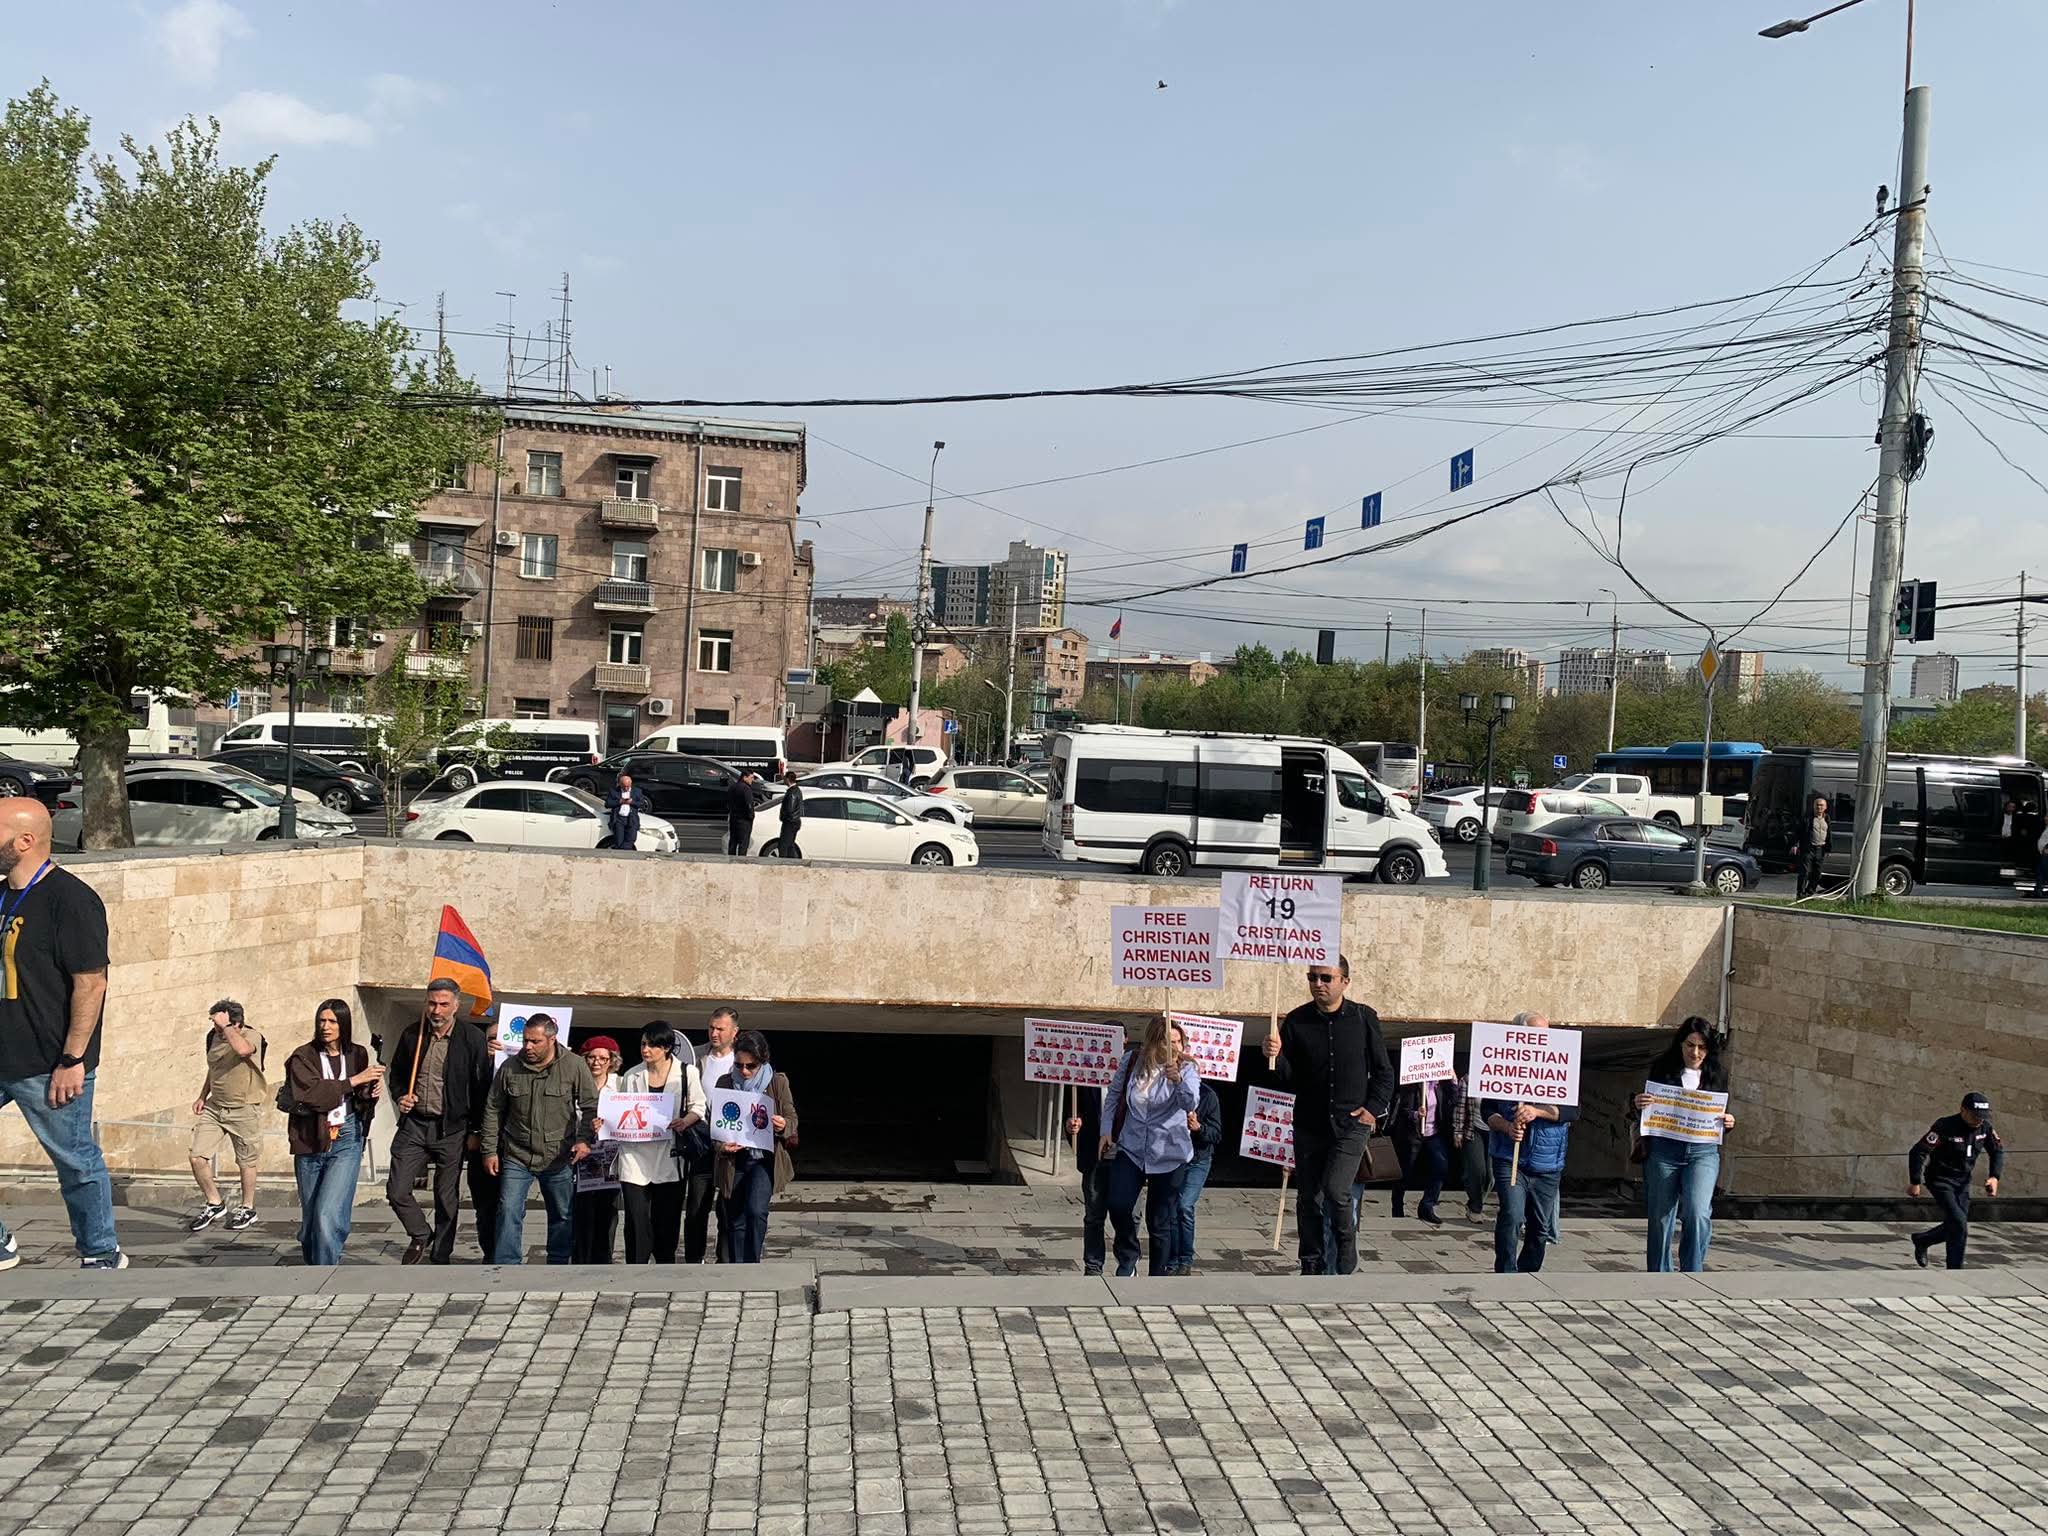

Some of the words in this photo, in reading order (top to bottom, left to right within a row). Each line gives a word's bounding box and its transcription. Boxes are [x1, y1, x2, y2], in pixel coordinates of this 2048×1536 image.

[1249, 876, 1313, 891] RETURN
[1265, 897, 1296, 920] 19
[1144, 912, 1187, 926] FREE
[1122, 930, 1210, 945] CHRISTIAN
[1237, 925, 1321, 943] CRISTIANS
[1123, 949, 1210, 964] ARMENIAN
[1231, 943, 1326, 961] ARMENIANS
[1123, 967, 1212, 983] HOSTAGES
[1183, 1021, 1207, 1029] ARMENIAN
[510, 1032, 524, 1043] YE
[1050, 1028, 1080, 1036] ARMENIAN
[1080, 1031, 1113, 1039] PRISONERS
[1402, 1037, 1426, 1047] PEACE
[1427, 1035, 1453, 1044] MEANS
[1505, 1031, 1549, 1046] FREE
[1420, 1047, 1434, 1060] 19
[1482, 1046, 1569, 1065] CHRISTIAN
[1408, 1061, 1446, 1073] CRISTIANS
[1481, 1063, 1568, 1082] ARMENIAN
[1401, 1072, 1430, 1083] RETURN
[1430, 1069, 1452, 1079] HOME
[1479, 1080, 1568, 1099] HOSTAGES
[750, 1103, 768, 1114] NO
[722, 1118, 743, 1132] YES
